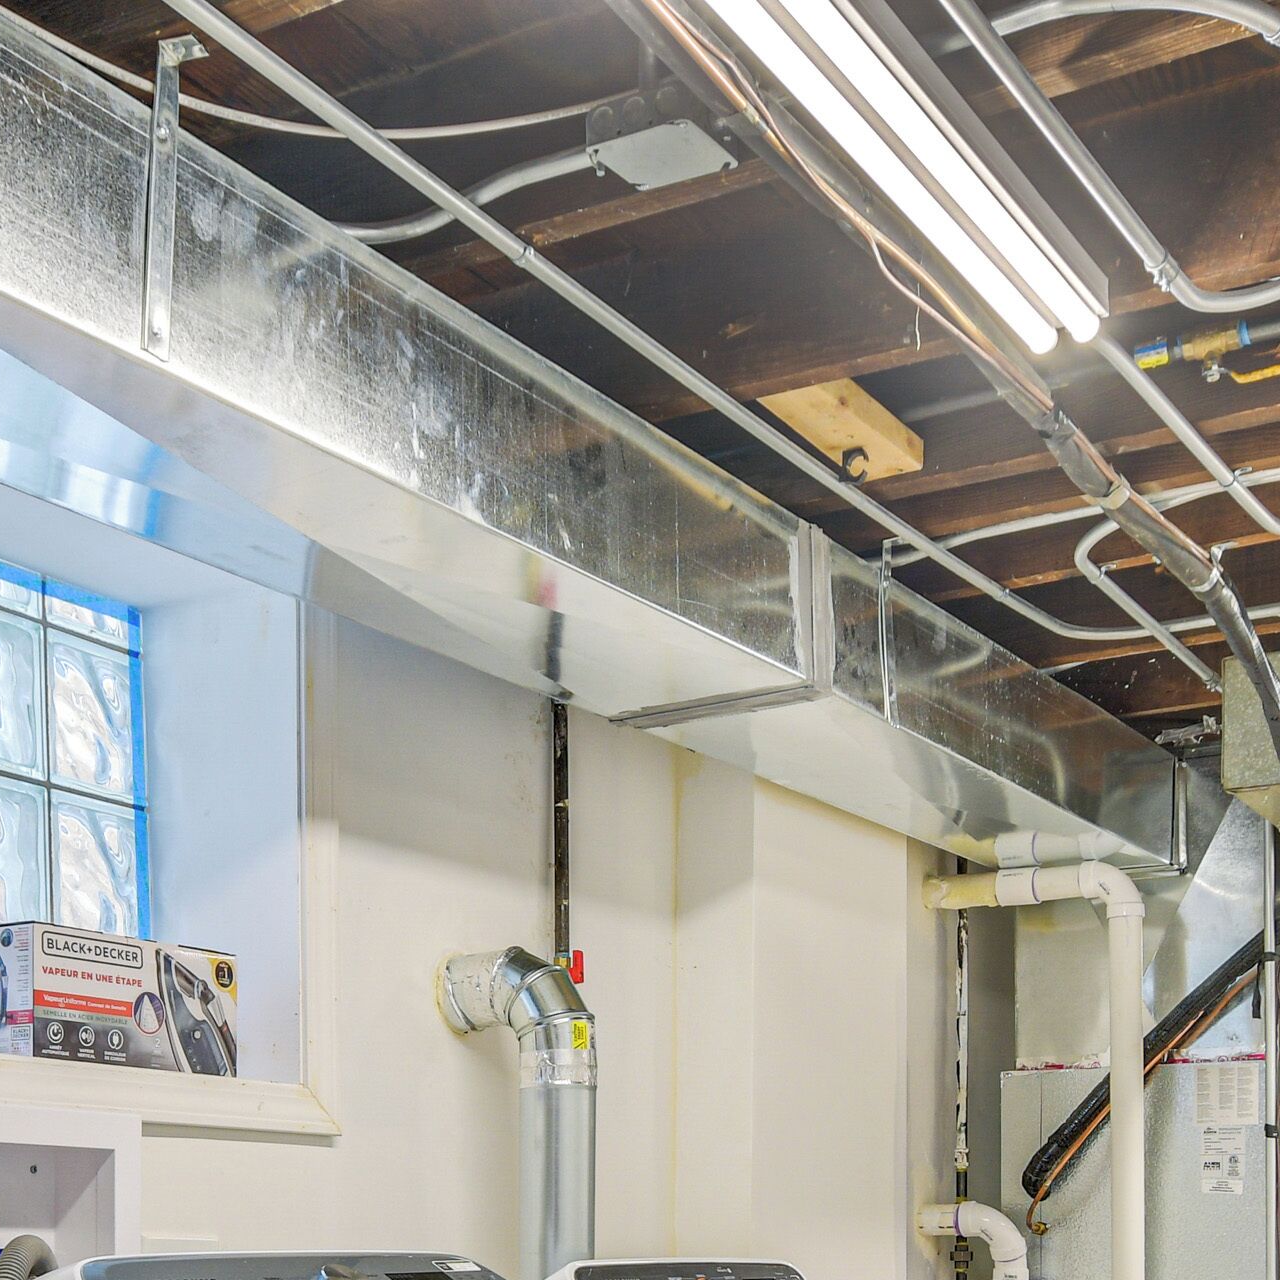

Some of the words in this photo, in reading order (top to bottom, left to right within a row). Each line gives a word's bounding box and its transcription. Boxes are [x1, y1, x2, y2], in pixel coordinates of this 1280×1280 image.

[47, 938, 139, 962] BLACK+DECKER
[42, 966, 79, 978] VAPEUR
[81, 971, 93, 981] EN
[95, 973, 113, 983] UNE
[115, 974, 143, 987] ÉTAPE
[43, 1009, 67, 1018] SEMELLE
[78, 1013, 94, 1021] ACIER
